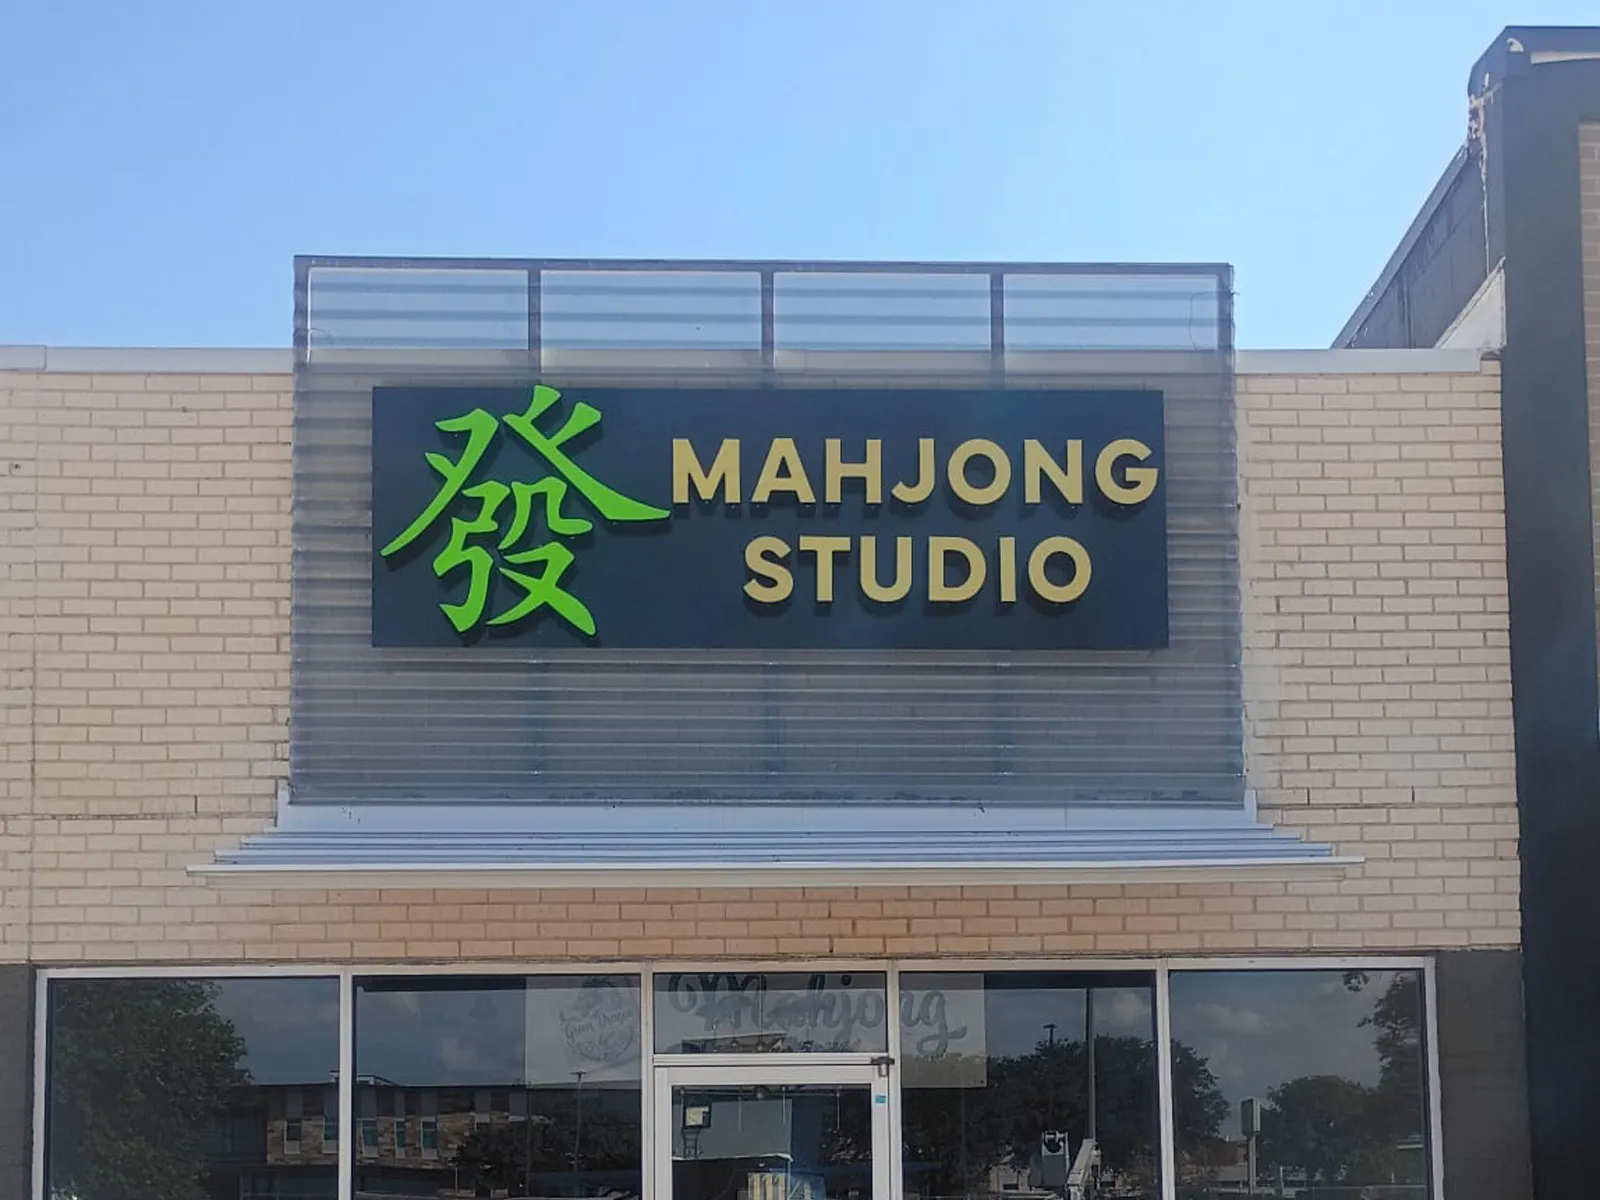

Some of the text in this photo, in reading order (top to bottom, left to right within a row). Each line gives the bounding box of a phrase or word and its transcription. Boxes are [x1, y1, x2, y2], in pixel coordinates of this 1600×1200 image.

[671, 437, 1160, 506] MAHJONG
[380, 385, 669, 636] 發
[743, 535, 1093, 604] STUDIO
